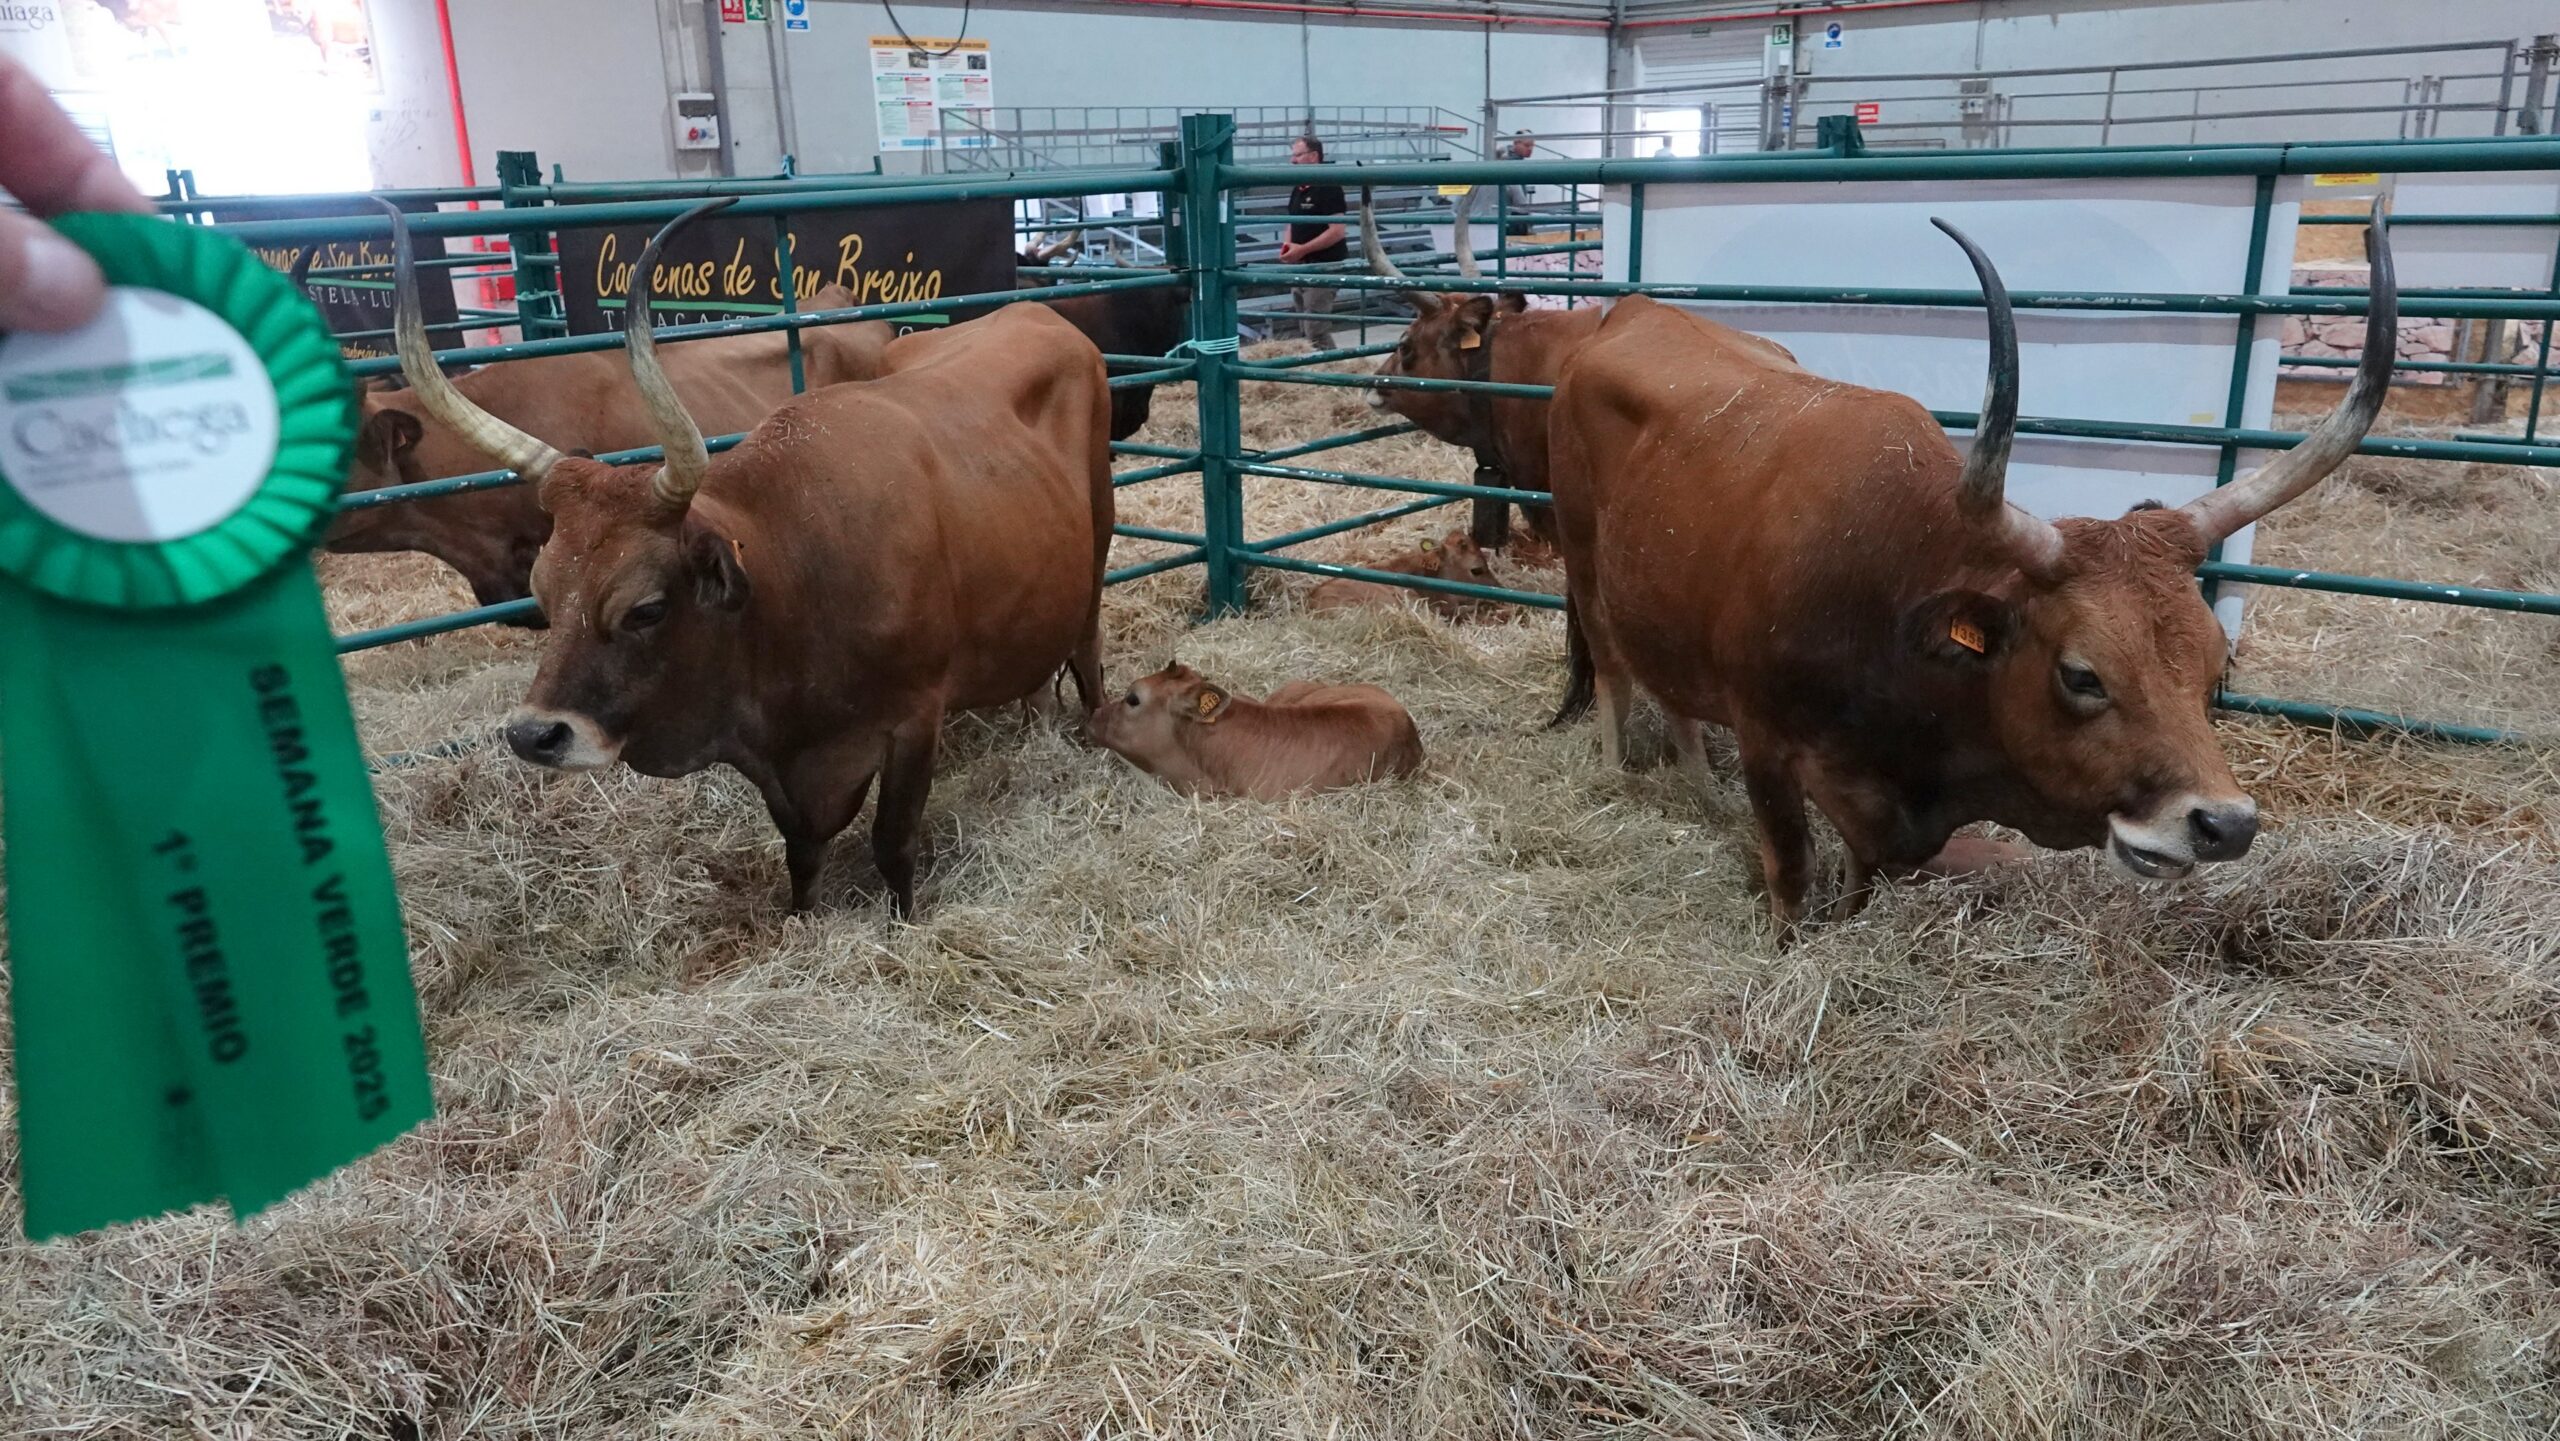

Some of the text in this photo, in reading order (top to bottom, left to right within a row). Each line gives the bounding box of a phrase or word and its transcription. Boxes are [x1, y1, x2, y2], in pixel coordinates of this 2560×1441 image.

[723, 236, 756, 296] de
[836, 233, 942, 304] Breixo
[166, 884, 250, 1066] PREMIO
[248, 663, 391, 1123] SEMANA VERDE 2025
